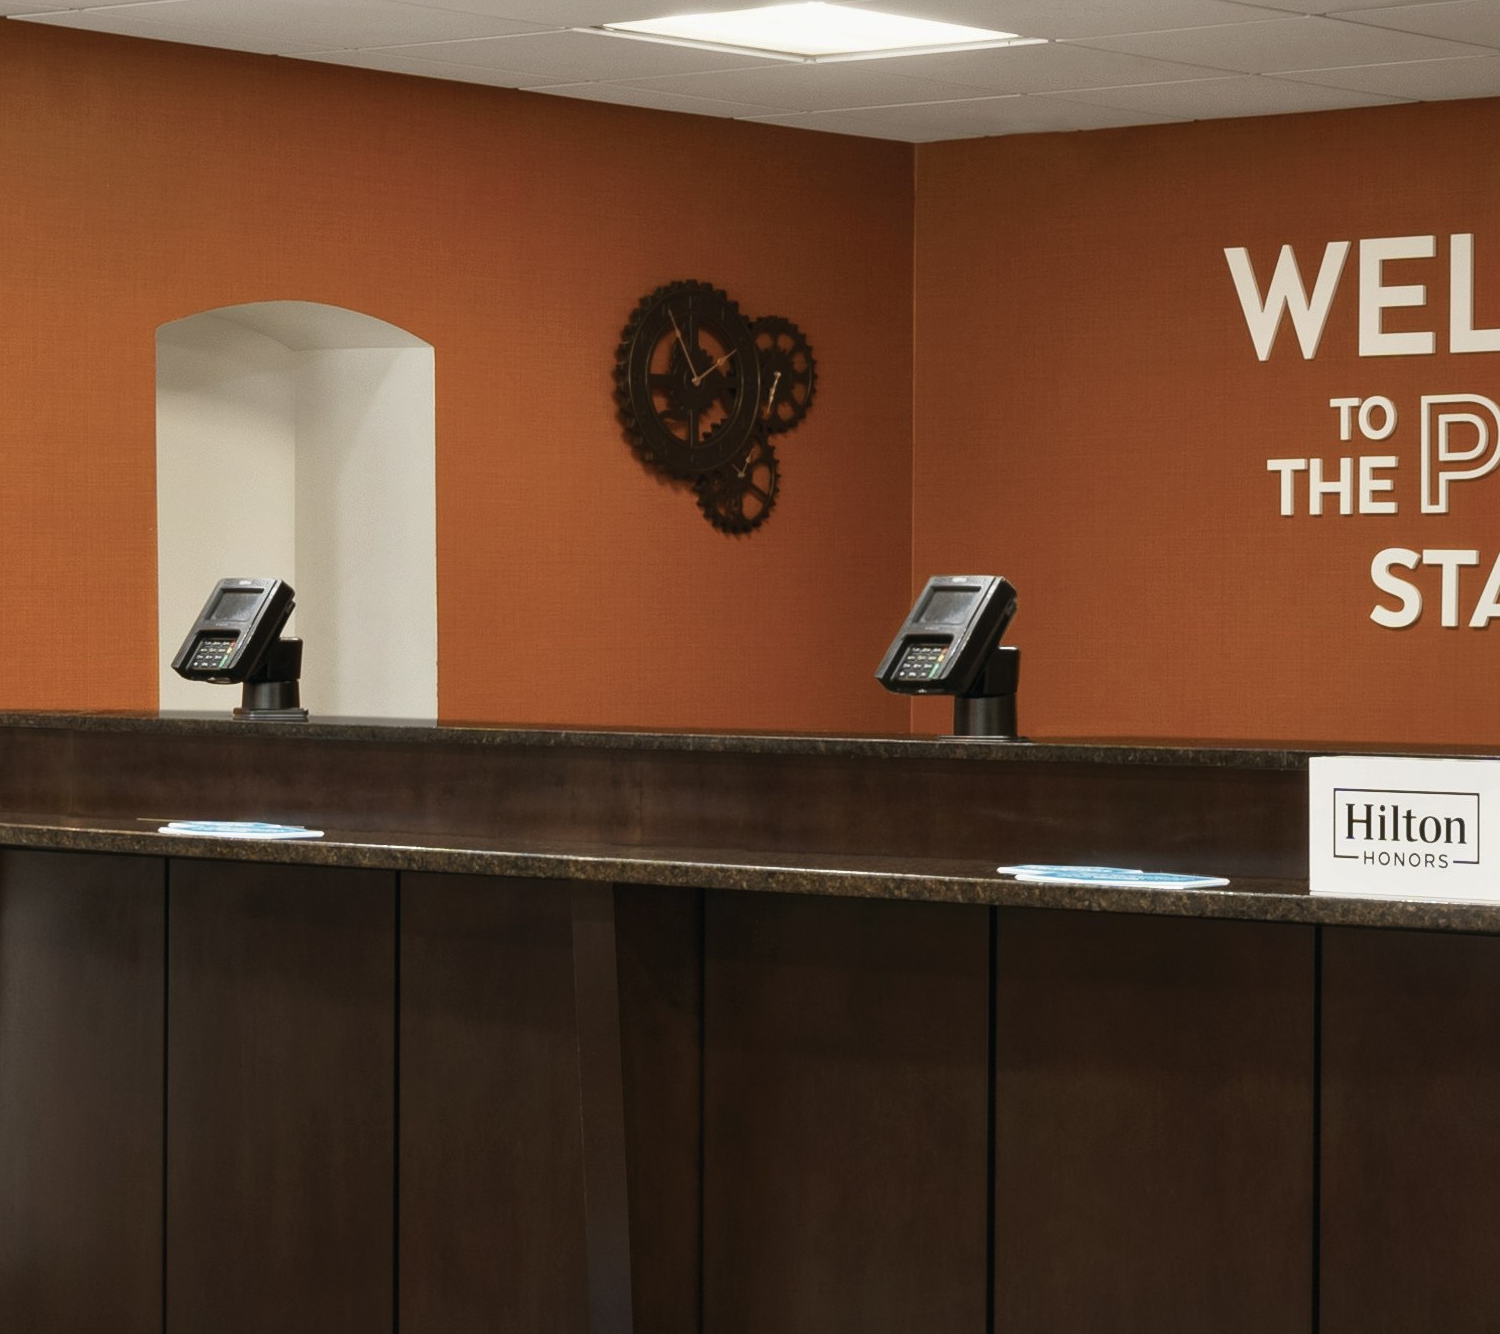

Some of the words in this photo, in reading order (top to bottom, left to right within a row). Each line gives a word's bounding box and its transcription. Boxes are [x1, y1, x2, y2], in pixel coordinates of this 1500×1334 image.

[1331, 395, 1397, 441] TO
[1267, 456, 1399, 517] THE
[1345, 802, 1467, 845] Hilton
[1363, 850, 1449, 869] HONORS
